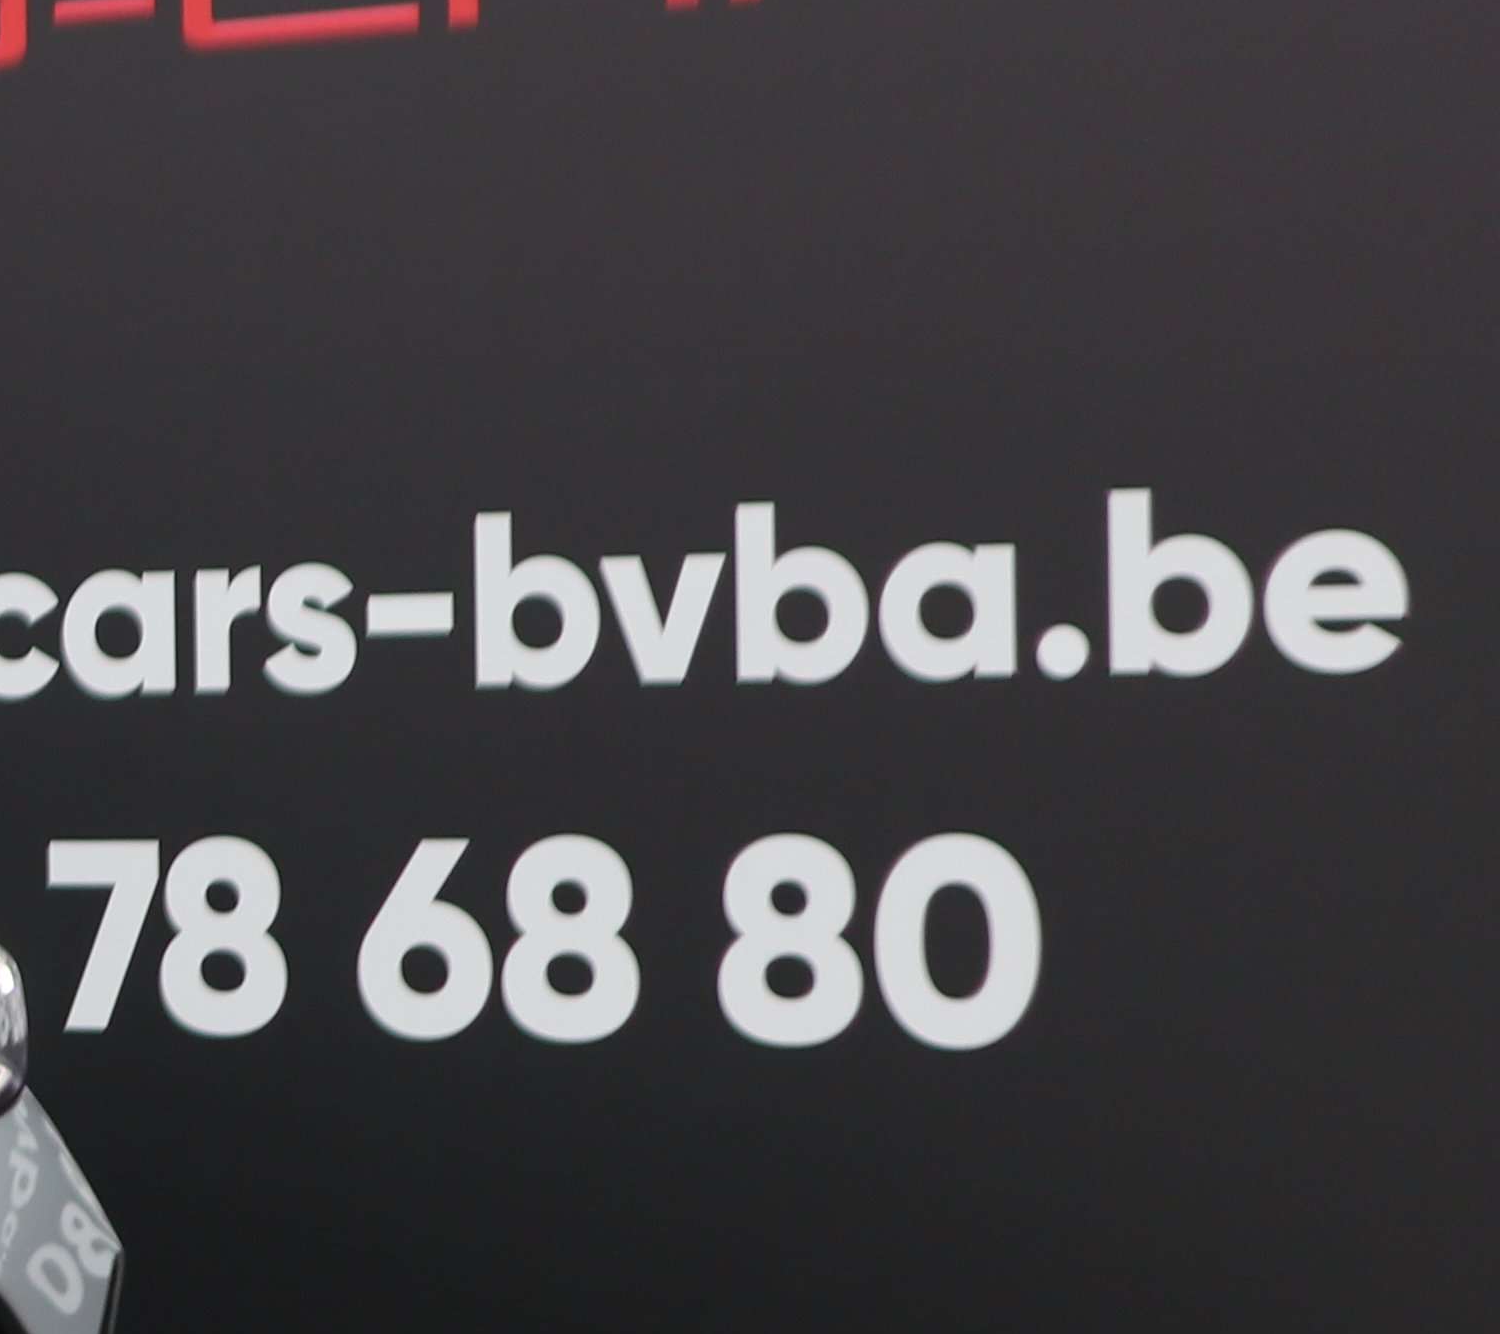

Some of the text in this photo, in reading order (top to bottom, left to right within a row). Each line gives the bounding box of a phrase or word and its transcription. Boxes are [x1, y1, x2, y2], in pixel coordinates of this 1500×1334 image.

[46, 832, 1043, 1051] 78 68 80
